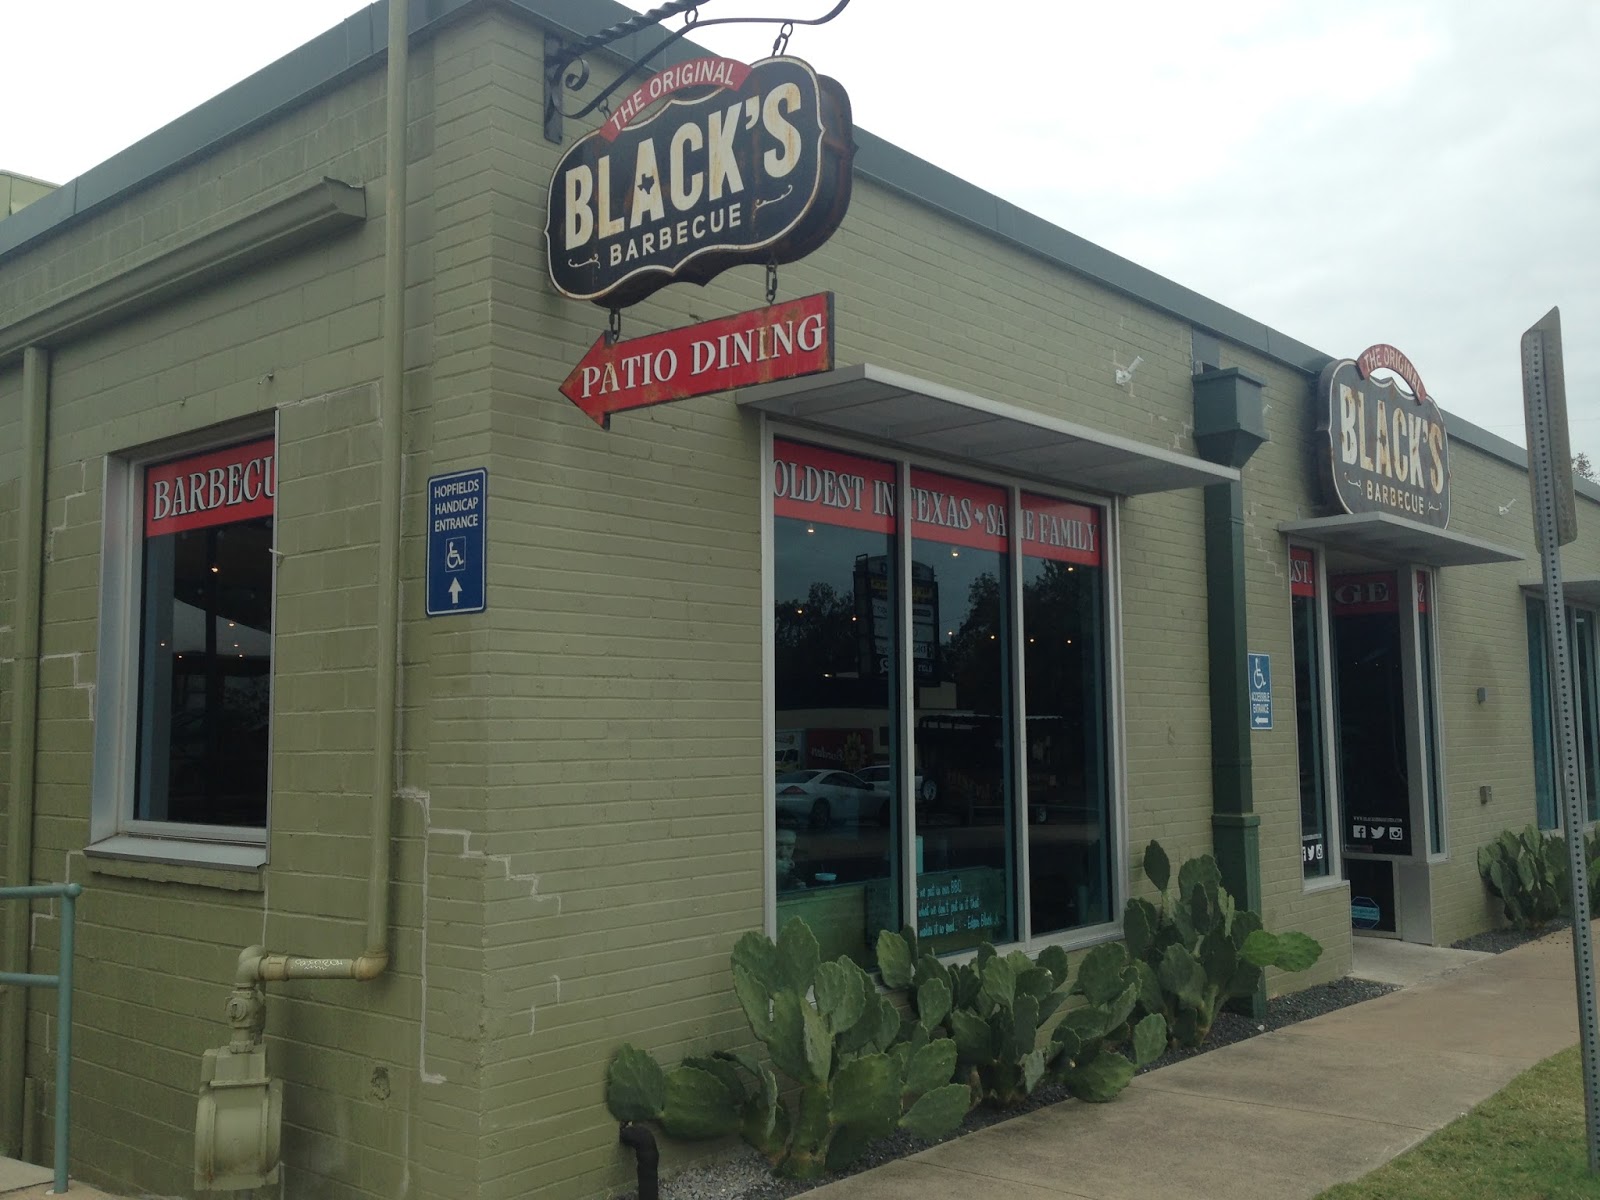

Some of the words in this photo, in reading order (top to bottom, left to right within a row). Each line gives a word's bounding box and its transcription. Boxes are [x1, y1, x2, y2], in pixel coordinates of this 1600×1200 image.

[610, 90, 646, 132] THE
[650, 60, 736, 96] ORIGINAL
[565, 82, 801, 250] BLACK'S
[610, 202, 742, 267] BARBECUE
[580, 348, 677, 399] PATIO
[691, 313, 826, 376] DINING
[1363, 348, 1381, 372] THE
[1384, 348, 1422, 397] ORIGINAL
[1339, 383, 1443, 494] BLACK'S
[434, 479, 480, 498] HOPFIELDS
[434, 496, 479, 515] HANDICAP
[773, 459, 864, 511] OLDEST
[873, 480, 895, 517] IN
[986, 503, 1034, 541] SAE
[1039, 513, 1097, 552] FAMILY
[1366, 480, 1424, 514] BARBECUE
[434, 513, 479, 532] ENTRANCE
